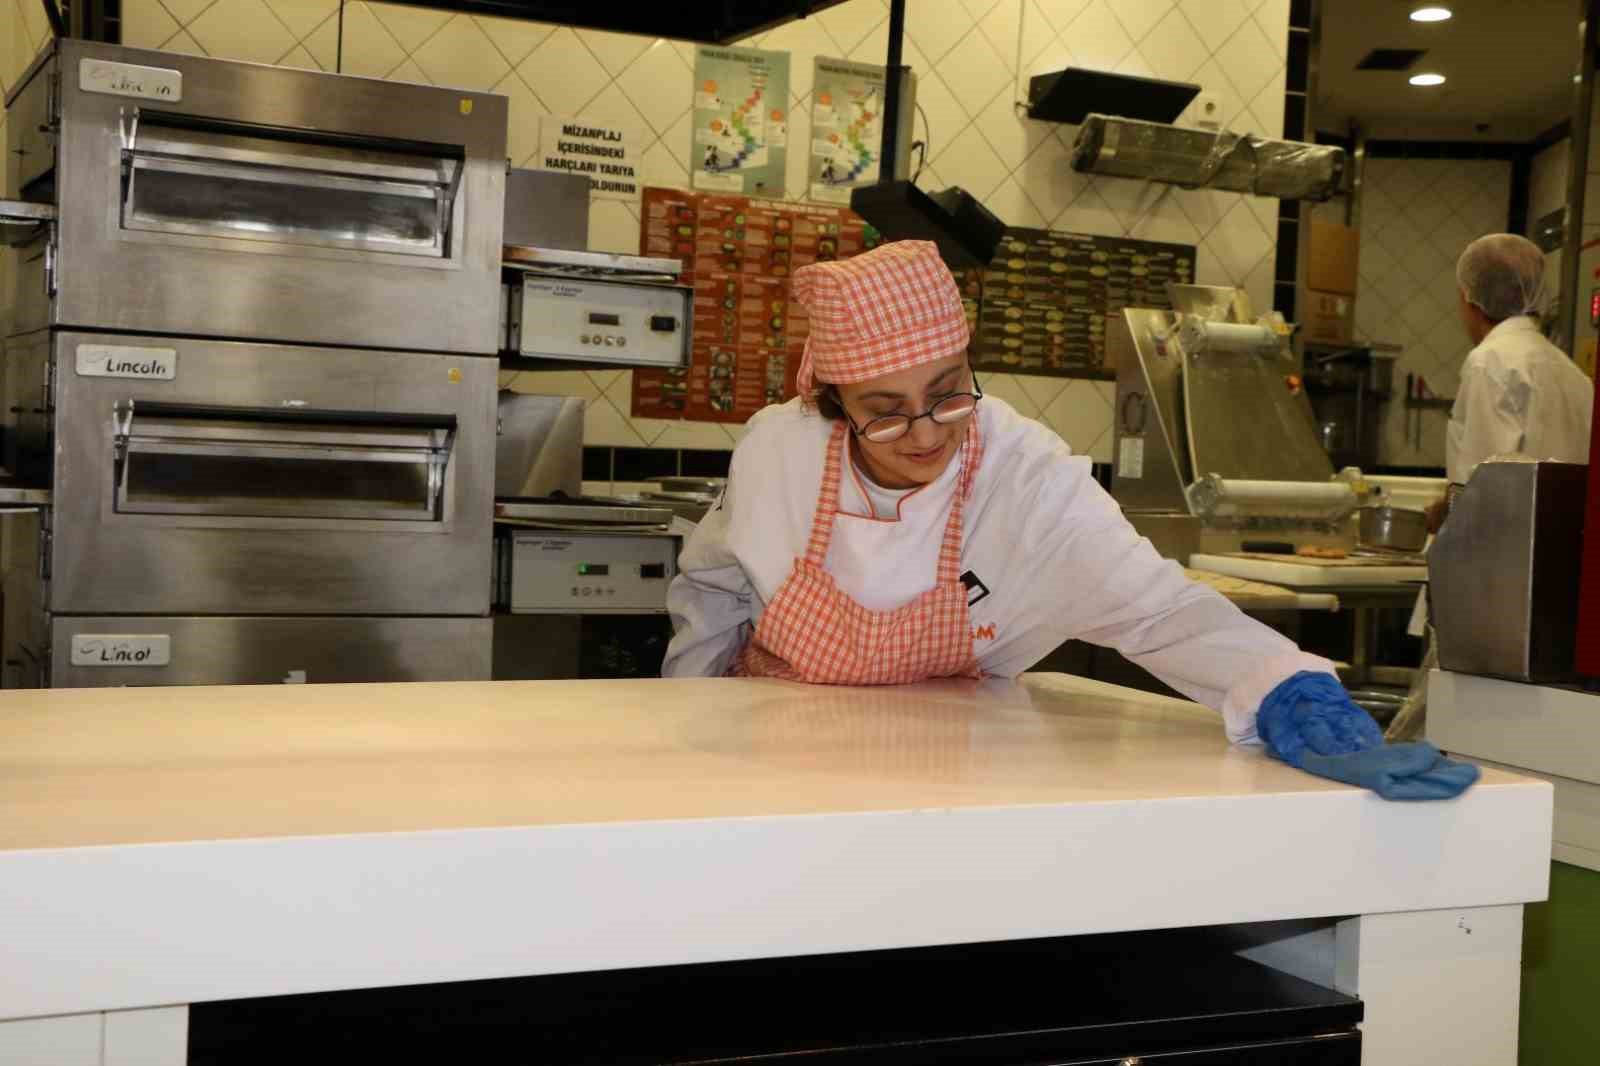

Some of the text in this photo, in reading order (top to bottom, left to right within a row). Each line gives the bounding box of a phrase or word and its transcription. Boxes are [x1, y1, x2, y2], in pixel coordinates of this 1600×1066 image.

[562, 124, 622, 142] MİZANPLAJ
[558, 139, 625, 159] İÇERİSİNDEKİ
[600, 163, 635, 177] YARIYA
[106, 359, 166, 375] Lincoln
